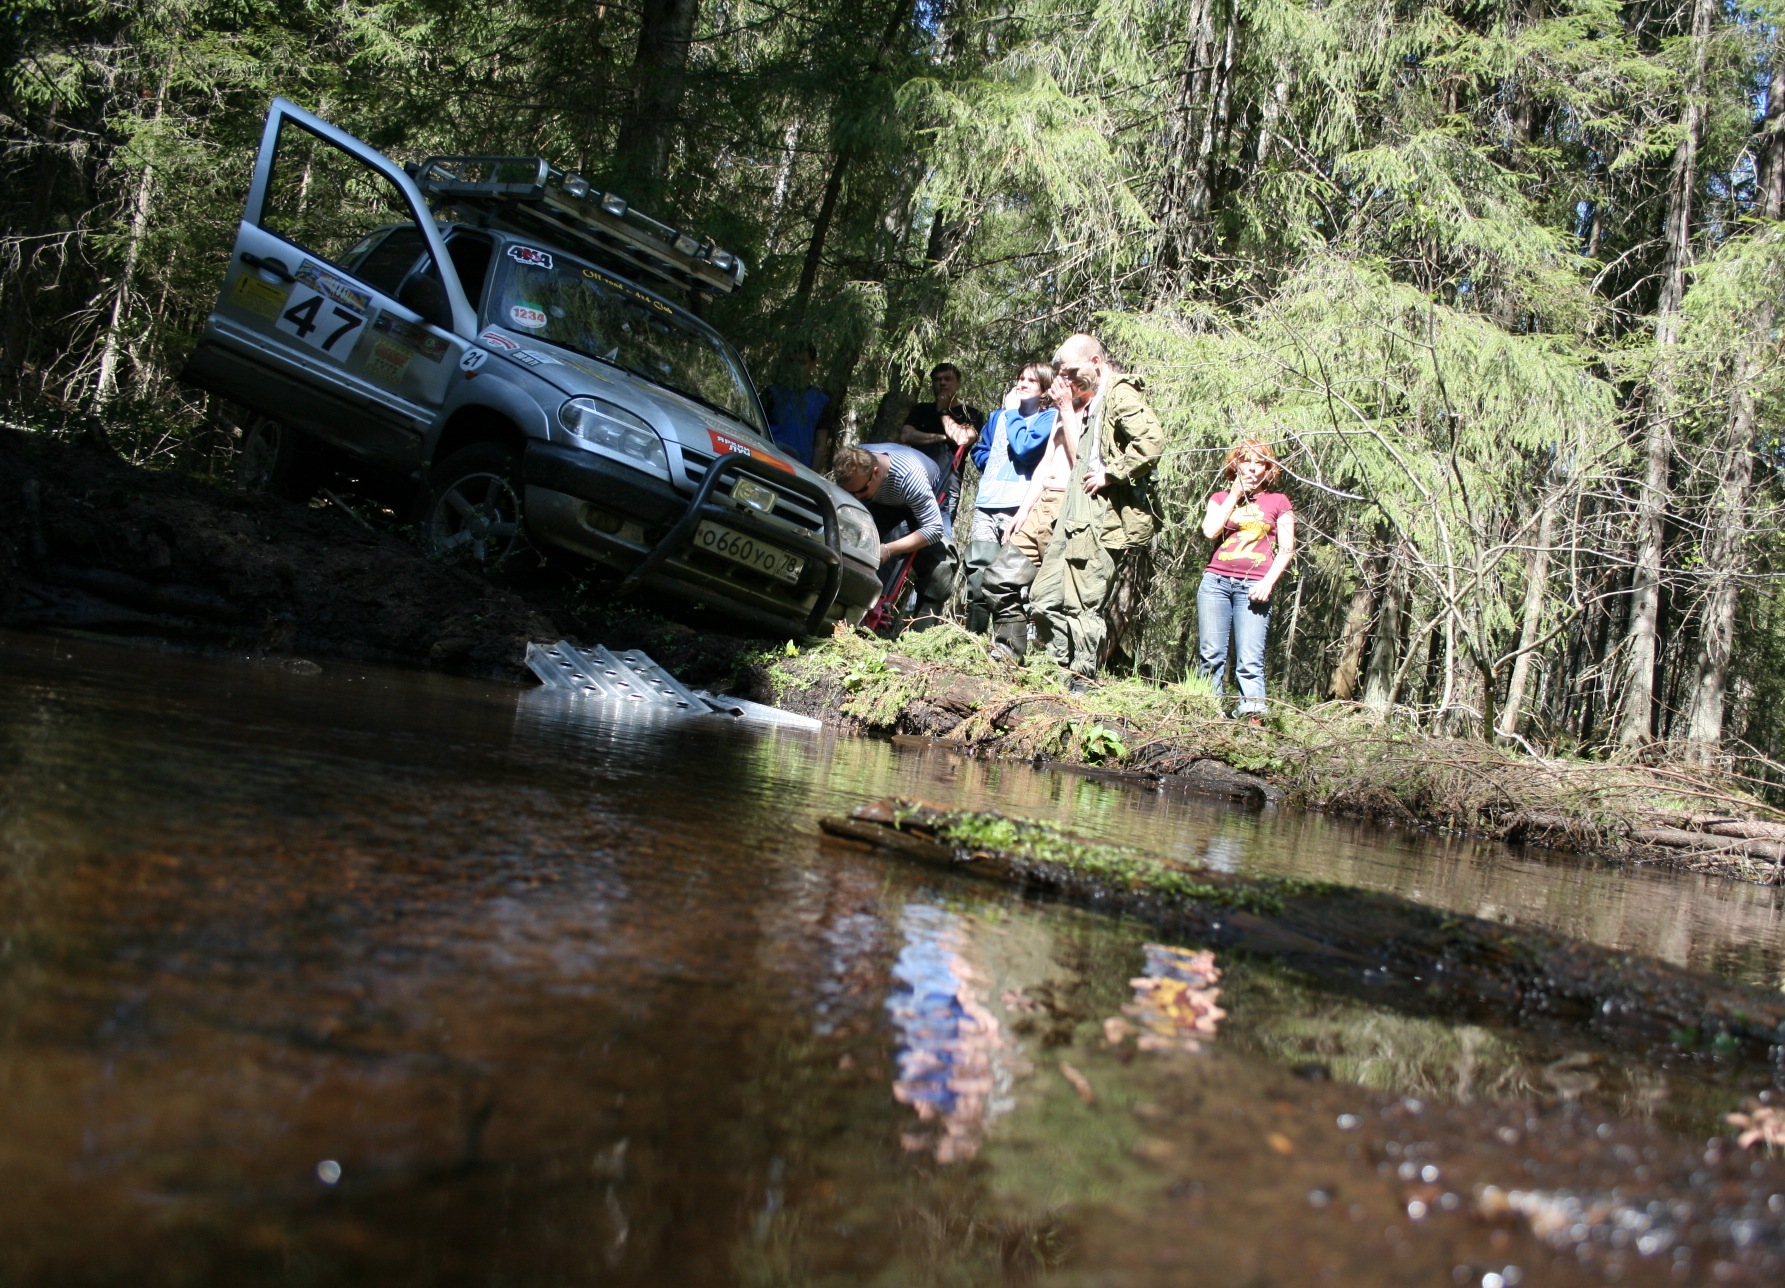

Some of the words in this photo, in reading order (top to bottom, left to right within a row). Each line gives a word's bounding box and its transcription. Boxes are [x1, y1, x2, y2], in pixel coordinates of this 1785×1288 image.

[513, 308, 546, 323] 1234
[653, 301, 674, 315] Club
[283, 295, 363, 352] 47
[462, 351, 484, 368] 21
[781, 554, 798, 573] 78
